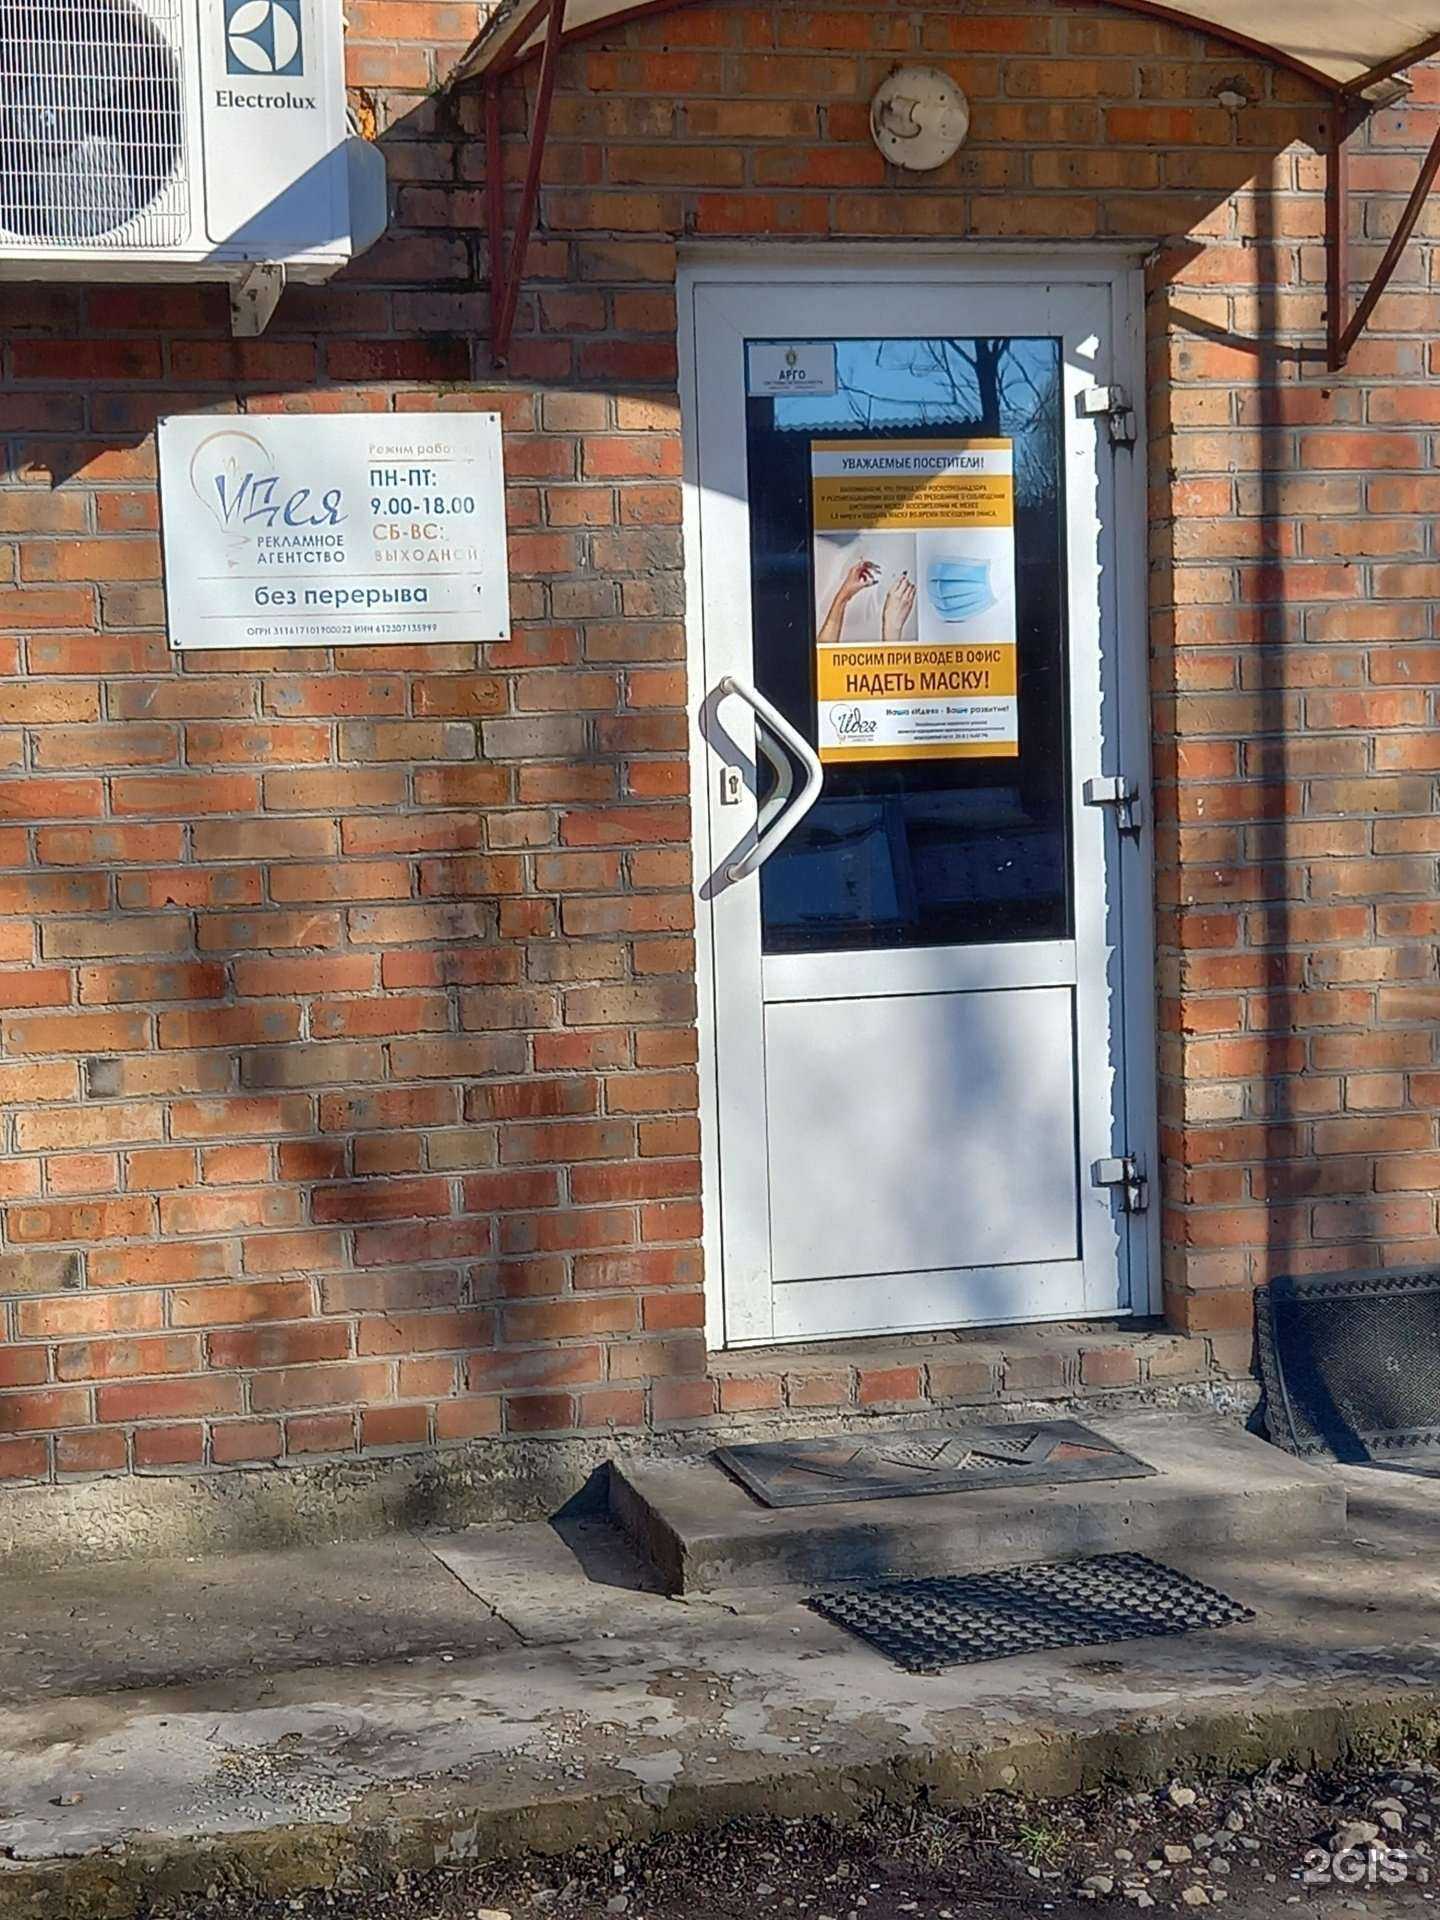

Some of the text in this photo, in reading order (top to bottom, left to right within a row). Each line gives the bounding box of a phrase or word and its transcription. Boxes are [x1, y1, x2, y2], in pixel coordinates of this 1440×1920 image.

[215, 89, 317, 110] Electrolux
[778, 369, 807, 380] АРГО
[416, 442, 461, 457] рабо
[842, 456, 985, 470] УВАЖАЕМЫЕ ПОСЕТИТЕЛИ!
[369, 468, 437, 487] ПН-ПТ:
[370, 496, 475, 515] 9.00-18.00
[372, 522, 444, 541] СБ-ВС:
[257, 535, 345, 548] РЕКЛАМНОЕ
[257, 551, 345, 565] АГЕНТСТВО
[254, 586, 428, 608] без перерыва
[247, 627, 271, 636] ОГРН
[354, 624, 374, 633] ИНН
[833, 650, 1001, 667] ПРОСИМ ПРИ ВХОДЕ В ОФИС
[846, 670, 990, 695] НАДЕТЬ МАСКУ!
